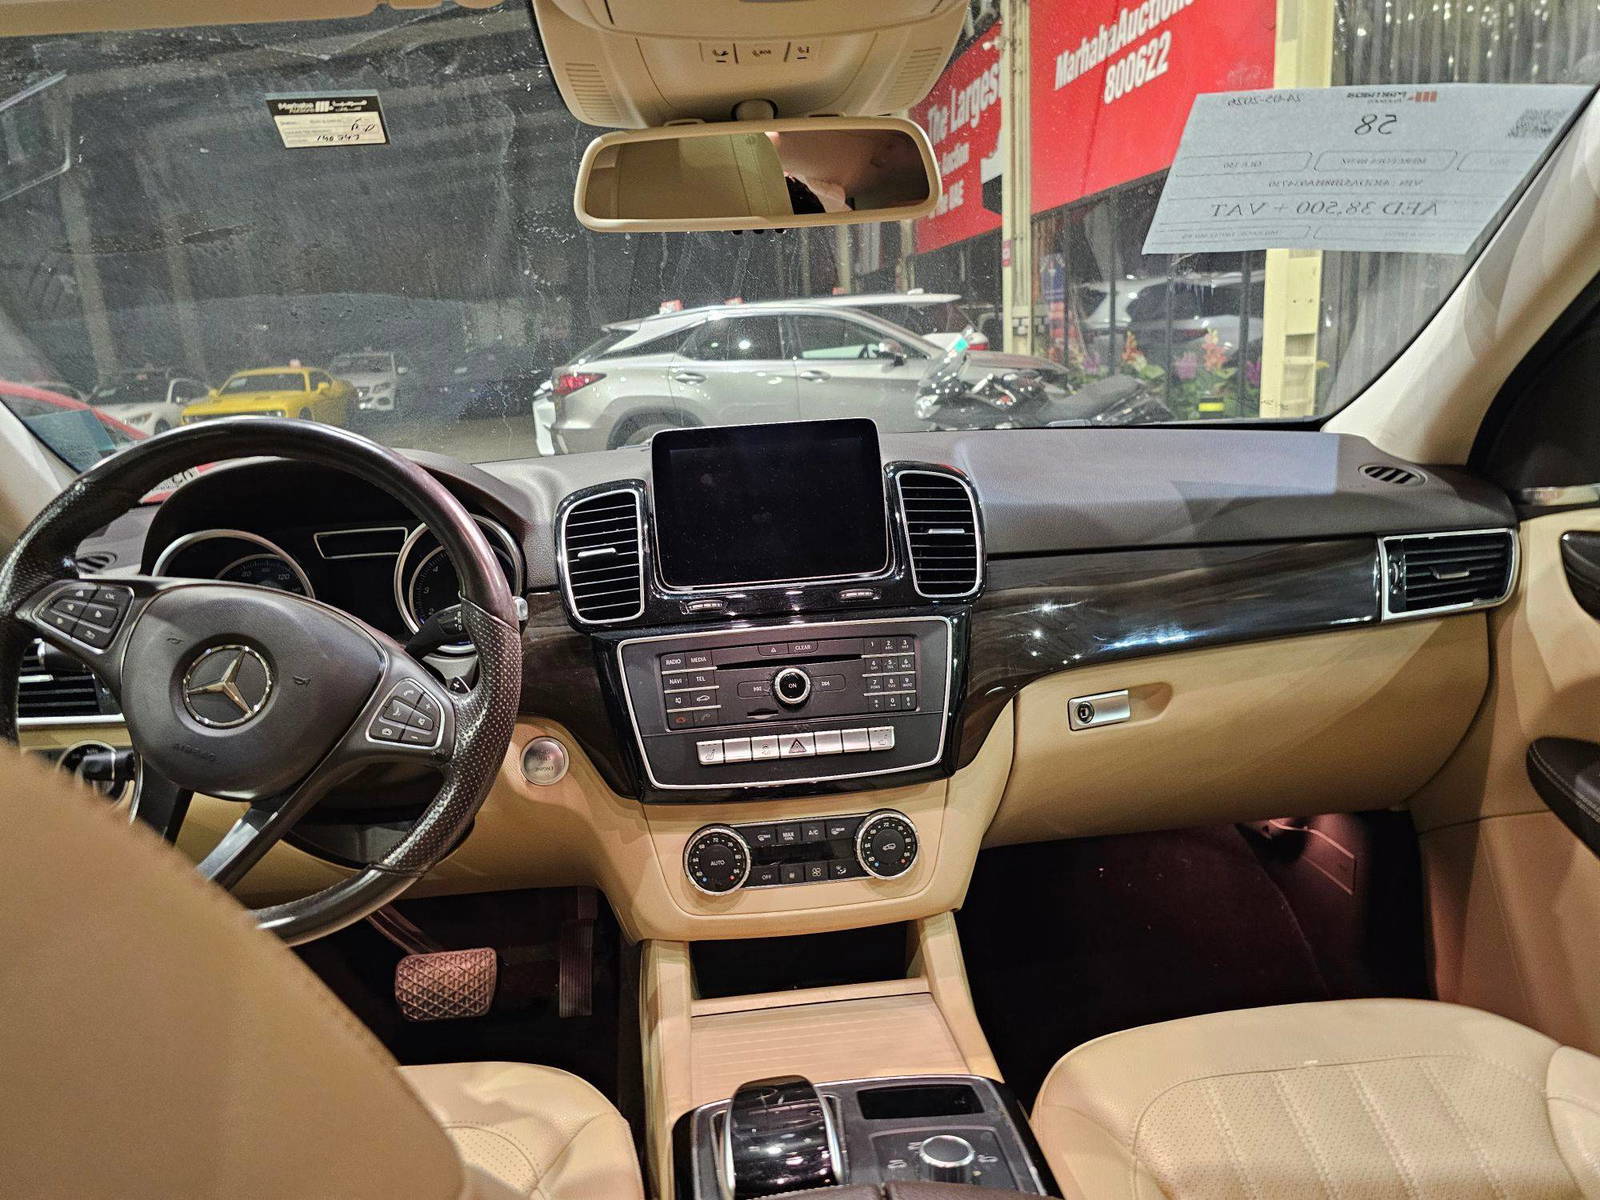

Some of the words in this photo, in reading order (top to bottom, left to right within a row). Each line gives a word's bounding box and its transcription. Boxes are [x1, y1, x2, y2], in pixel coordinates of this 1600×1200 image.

[1055, 0, 1195, 91] MarhabaAuctio
[1103, 30, 1172, 104] 800622
[949, 62, 1001, 130] Larges
[939, 143, 970, 176] uction
[665, 658, 682, 666] RADIO
